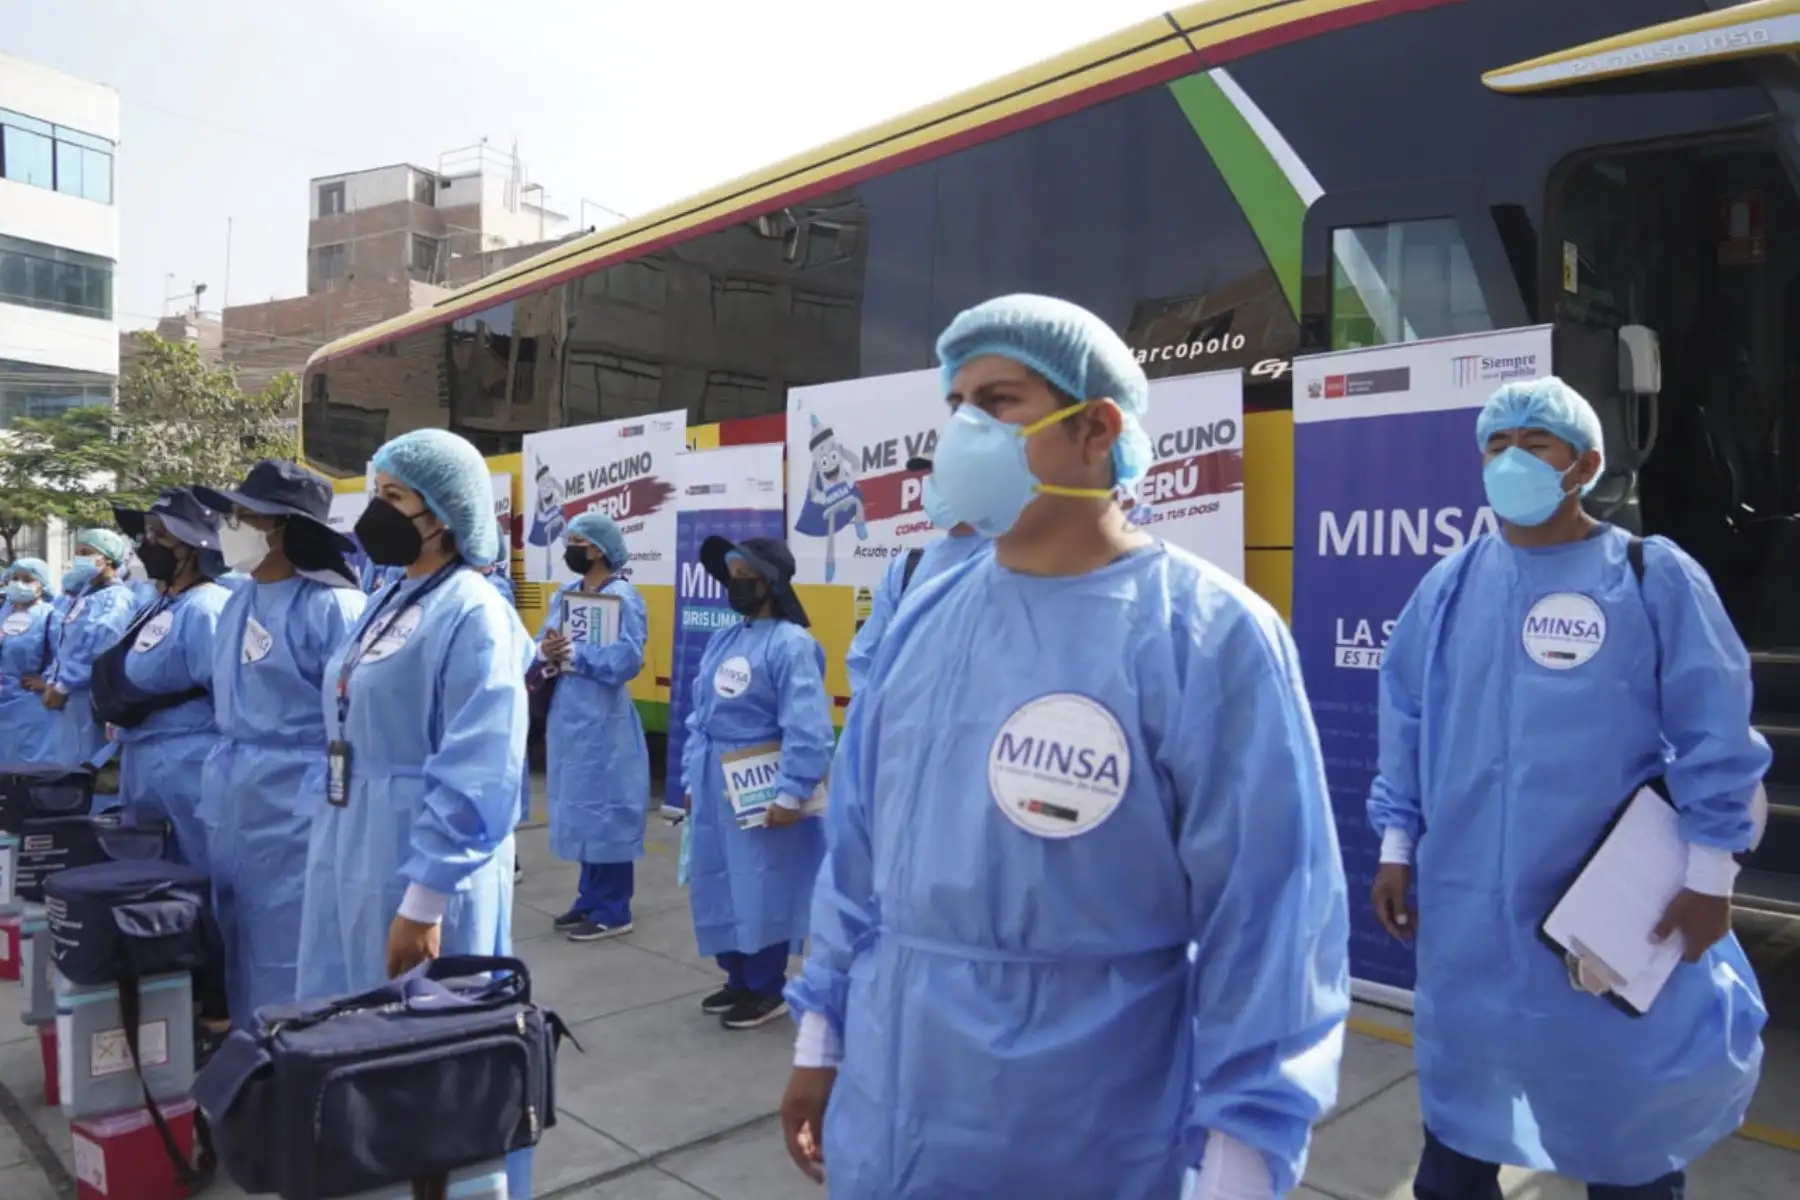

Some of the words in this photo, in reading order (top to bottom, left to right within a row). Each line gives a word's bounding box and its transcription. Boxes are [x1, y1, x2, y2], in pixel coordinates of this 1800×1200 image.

[1132, 333, 1246, 365] arcopolo
[1482, 355, 1536, 370] Siempre
[862, 439, 898, 472] ME
[1151, 419, 1236, 461] CUNO
[564, 475, 585, 499] ME
[587, 451, 653, 490] VACUNO
[1318, 505, 1499, 556] MINSA
[853, 544, 888, 558] Acude
[1336, 617, 1375, 647] LA
[1526, 616, 1600, 639] MINSA
[1343, 650, 1360, 665] ES
[997, 732, 1120, 787] MINSA
